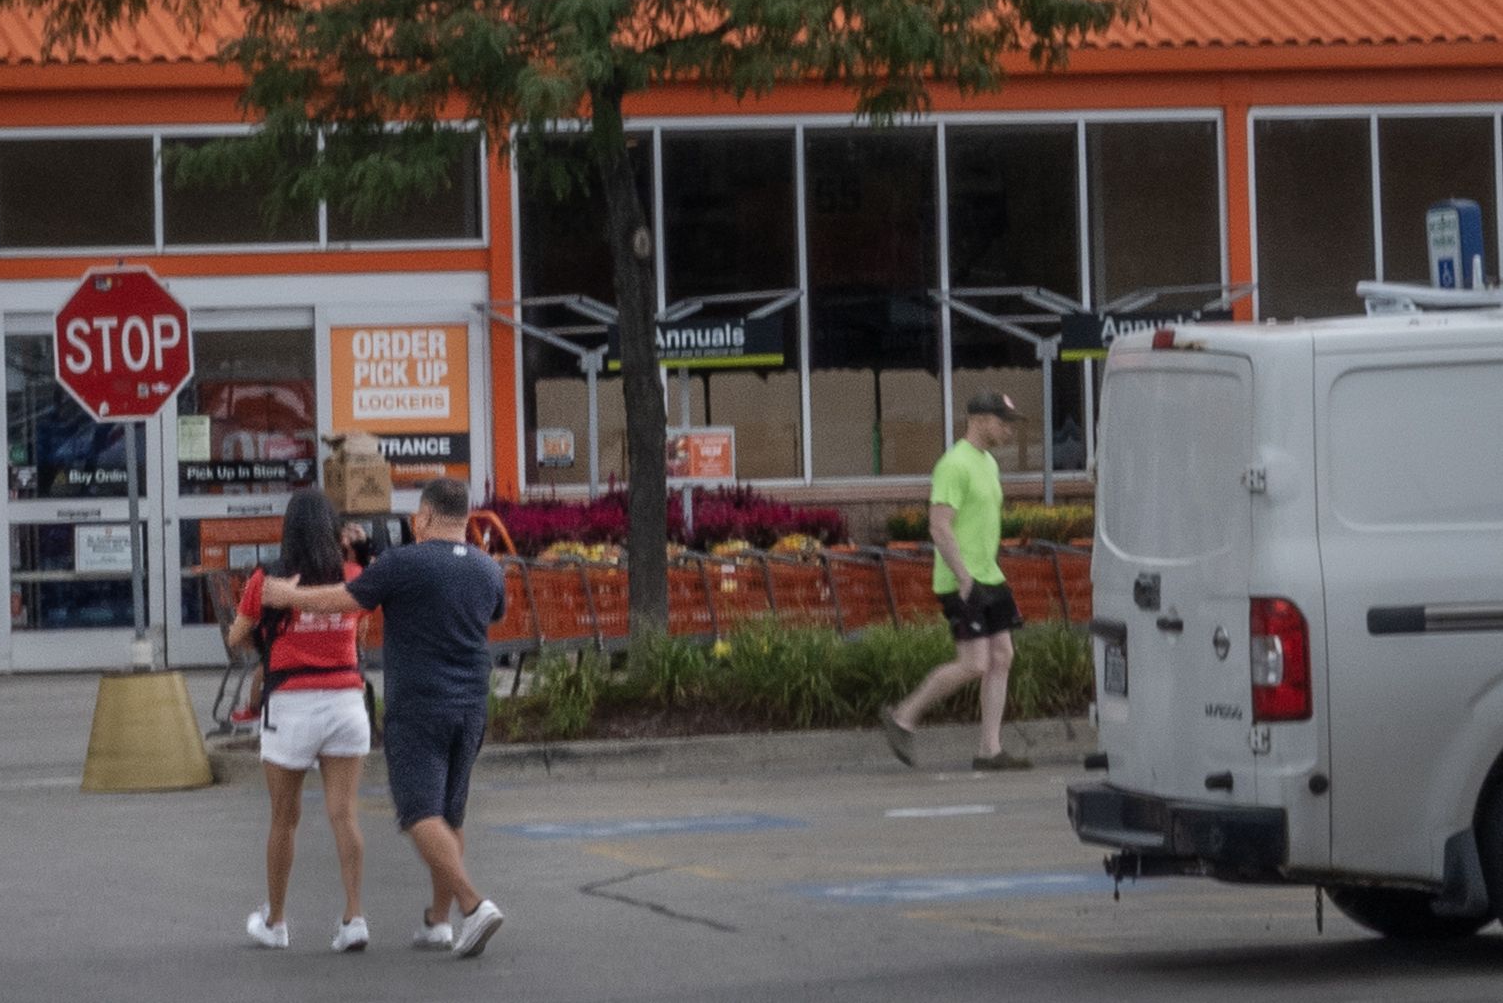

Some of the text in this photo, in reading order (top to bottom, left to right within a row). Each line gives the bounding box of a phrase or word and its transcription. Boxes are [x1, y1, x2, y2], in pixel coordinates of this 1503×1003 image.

[65, 315, 181, 374] STOP
[352, 329, 446, 359] ORDER
[354, 359, 448, 387] PICK UP
[358, 392, 445, 410] LOCKERS
[380, 437, 451, 457] TRANCE
[69, 468, 128, 485] Buy Onlin
[187, 465, 286, 480] Pick Up In Store
